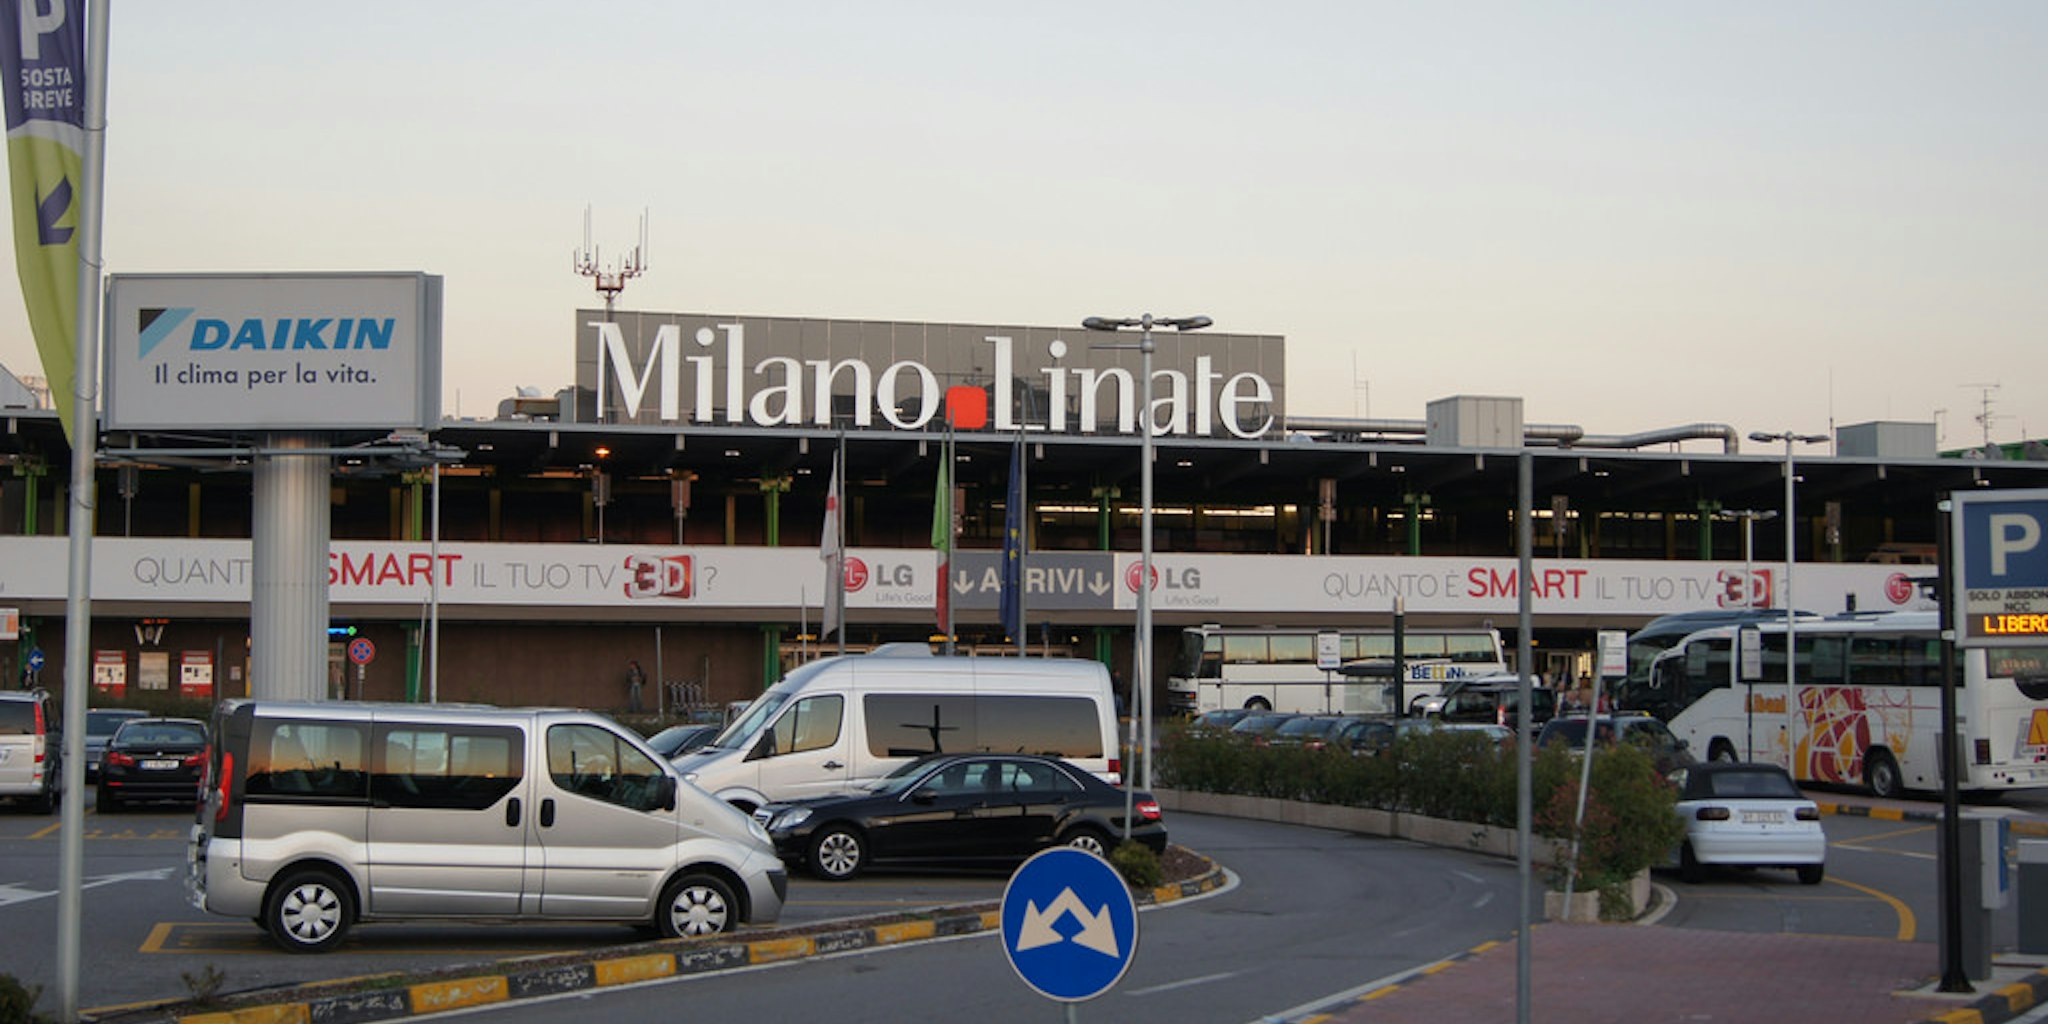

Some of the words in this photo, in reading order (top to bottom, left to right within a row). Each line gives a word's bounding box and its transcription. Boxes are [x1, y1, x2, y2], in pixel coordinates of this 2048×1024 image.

[21, 0, 66, 60] P
[21, 67, 73, 87] SOSTA
[189, 318, 396, 351] DAIKIN
[155, 363, 168, 384] Il
[177, 363, 238, 384] clima
[248, 368, 287, 390] per
[296, 362, 317, 384] la
[326, 363, 377, 384] vita.
[587, 321, 940, 430] Milano
[985, 336, 1274, 439] Linate
[1989, 513, 2041, 576] P
[134, 557, 251, 587] QUANT
[473, 563, 496, 588] IL
[505, 563, 570, 589] TUO
[579, 564, 616, 589] TV
[624, 554, 695, 599] 3D
[876, 564, 913, 587] LG
[979, 567, 1084, 594] ARIVI
[1165, 568, 1201, 590] LG
[1324, 573, 1438, 600] QUANTO
[1596, 577, 1615, 600] IL
[1622, 577, 1674, 600] TUO
[1680, 578, 1711, 600] TV
[904, 593, 933, 604] Good
[1193, 596, 1219, 606] Good
[1969, 591, 2001, 601] SOLO
[2004, 602, 2031, 612] NCC
